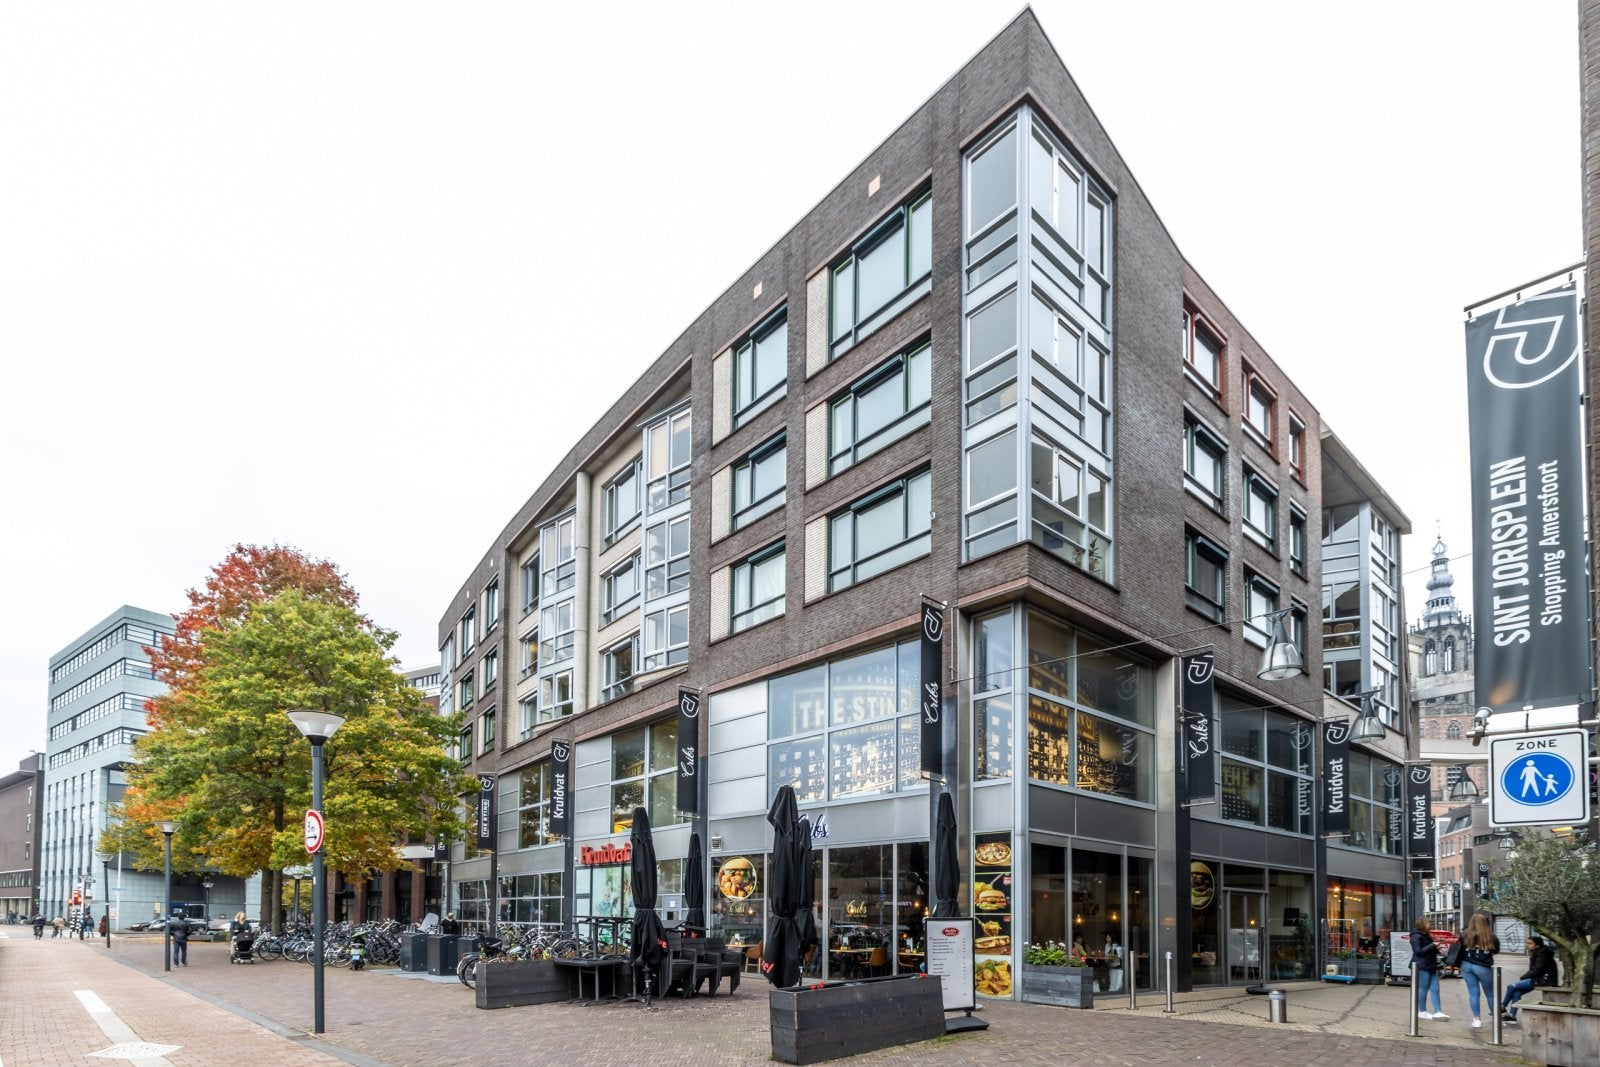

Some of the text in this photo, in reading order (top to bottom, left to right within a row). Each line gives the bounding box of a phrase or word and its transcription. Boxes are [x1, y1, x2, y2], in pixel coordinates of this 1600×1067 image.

[1489, 456, 1531, 647] SINT JORISPLEIN
[1537, 459, 1567, 626] Shopping Amersfoort
[800, 697, 846, 729] THE
[923, 681, 938, 724] Cribs
[1189, 717, 1208, 758] Cribs
[1516, 739, 1557, 750] ZONE
[680, 746, 695, 777] Cribs
[553, 773, 565, 819] Kruidvat
[1328, 757, 1343, 813] Kruidvat
[799, 814, 829, 838] ibs
[1412, 794, 1426, 839] Kruidvat
